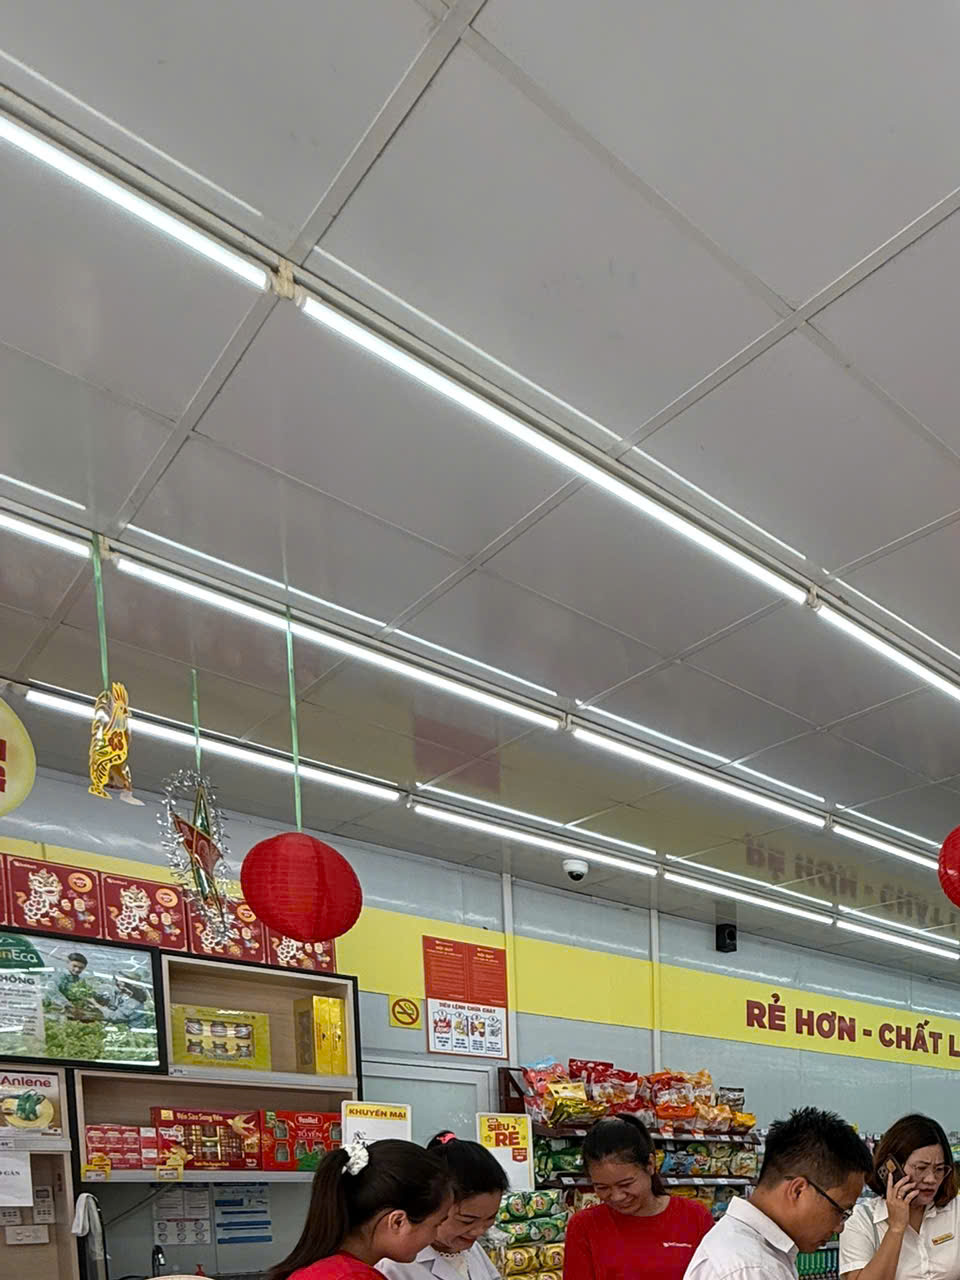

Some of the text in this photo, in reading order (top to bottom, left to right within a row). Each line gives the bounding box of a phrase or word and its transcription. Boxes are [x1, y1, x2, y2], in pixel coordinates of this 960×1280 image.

[746, 993, 786, 1031] RẺ
[796, 1009, 855, 1042] HƠN
[879, 1020, 943, 1055] CHẤT
[1, 1075, 52, 1088] Anlene
[348, 1106, 387, 1118] KHUYẾN
